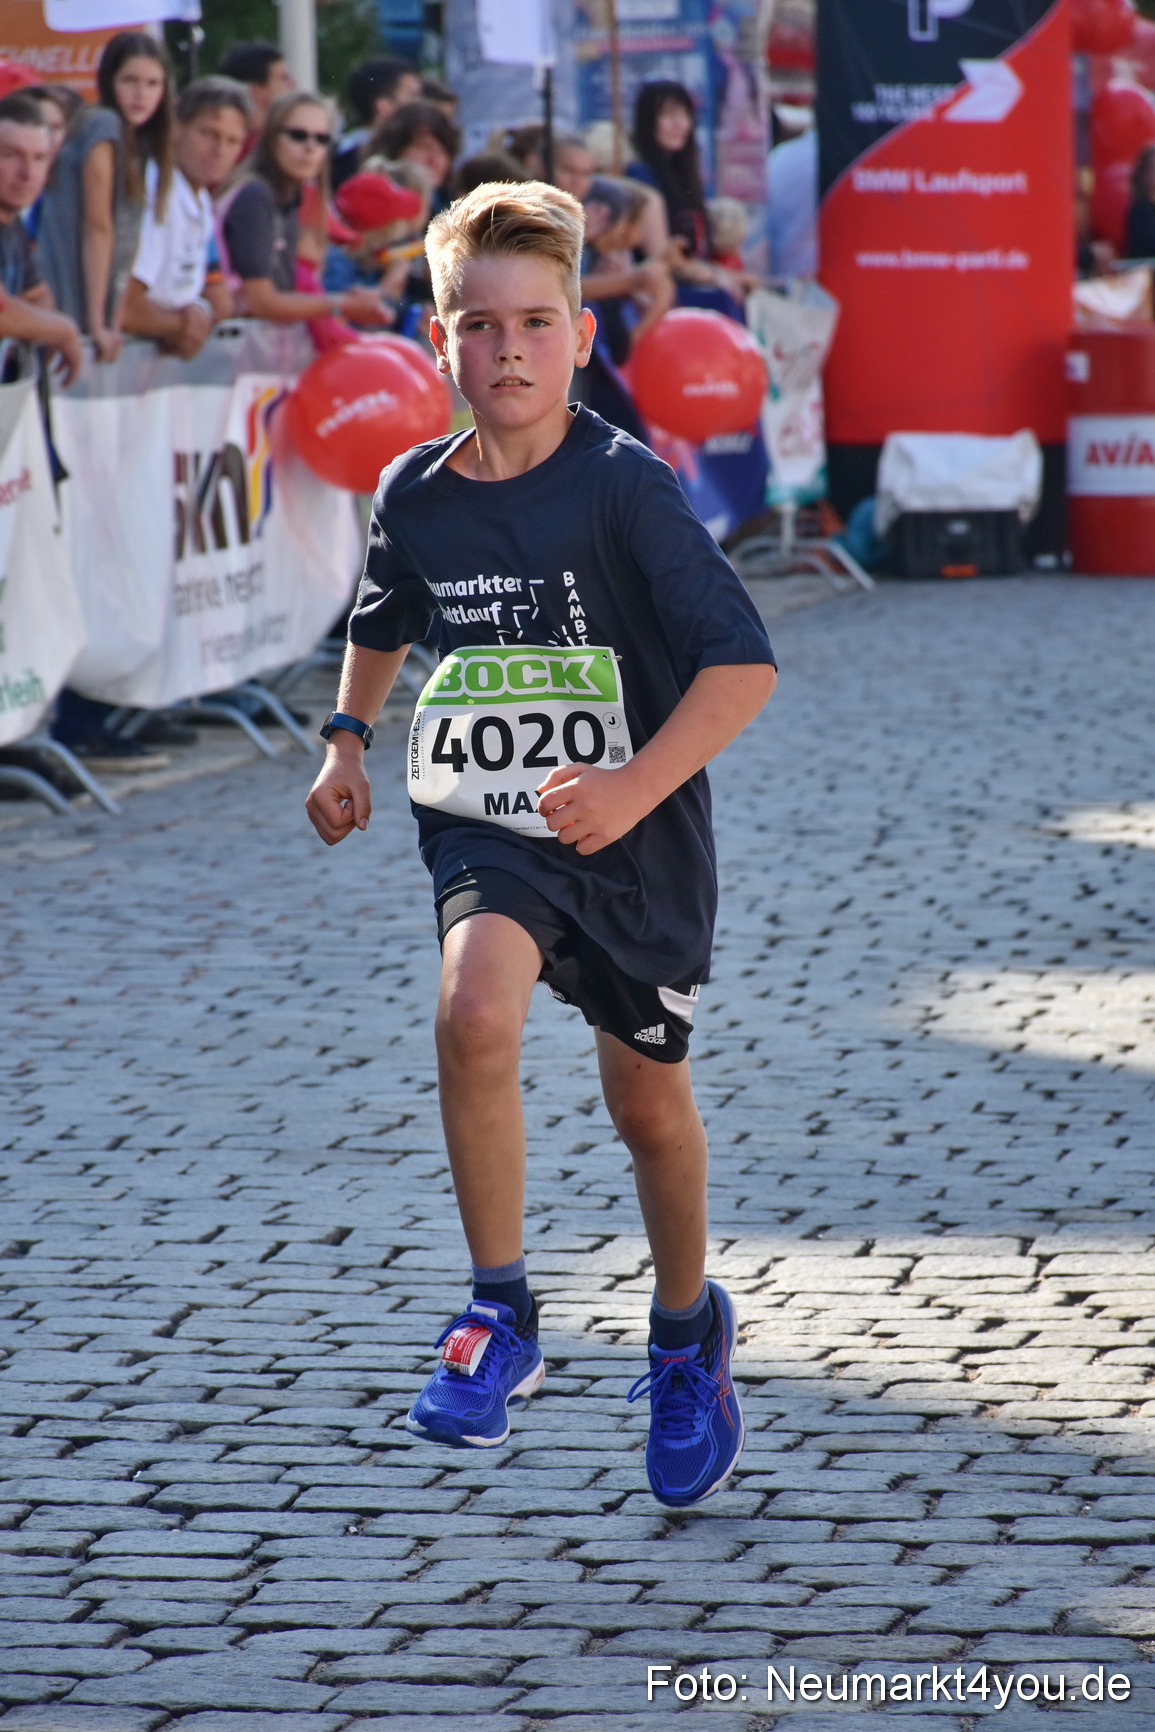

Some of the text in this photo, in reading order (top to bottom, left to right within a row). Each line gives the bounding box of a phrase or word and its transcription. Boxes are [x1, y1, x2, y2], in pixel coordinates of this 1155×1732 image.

[853, 169, 1028, 197] BMW Laufsport
[431, 656, 600, 697] BOCK
[431, 711, 606, 773] 4020
[634, 1031, 667, 1045] adidas
